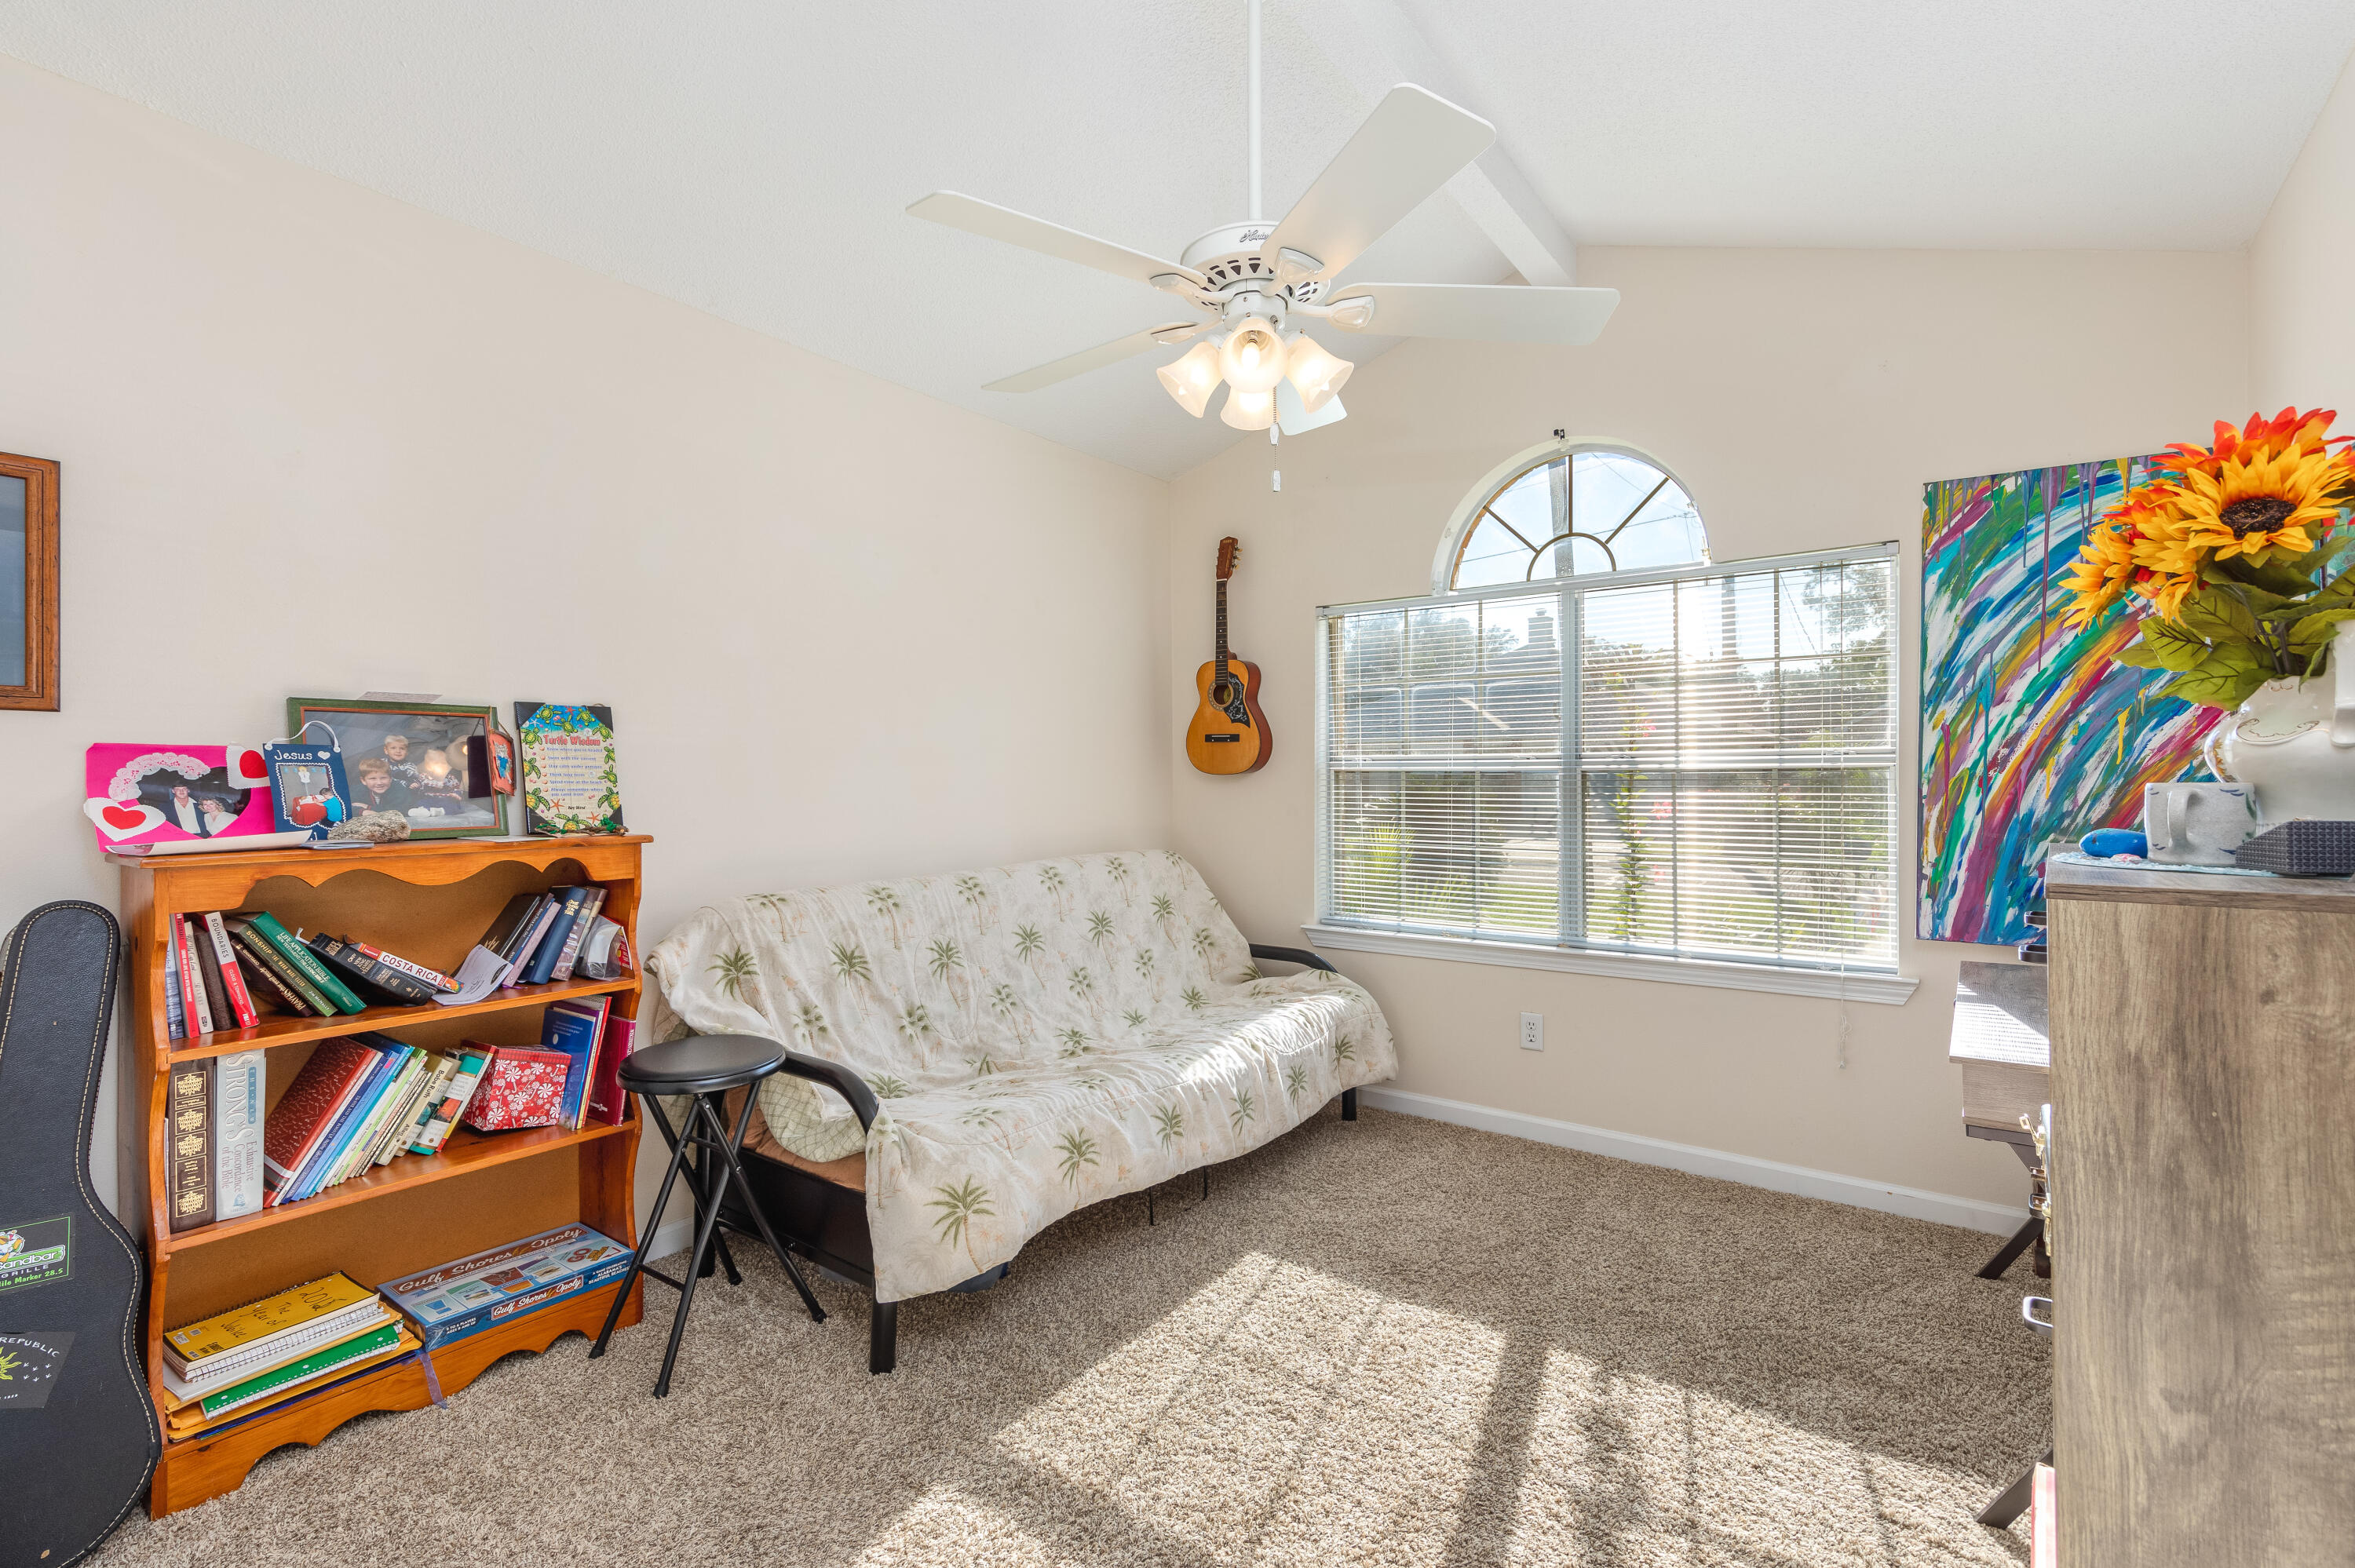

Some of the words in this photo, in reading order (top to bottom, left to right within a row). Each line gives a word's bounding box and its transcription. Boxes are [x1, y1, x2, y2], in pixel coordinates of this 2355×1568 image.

[543, 735, 568, 745] Turtle
[570, 735, 601, 746] Wisdom
[274, 750, 312, 760] Jesus
[211, 918, 228, 957] BOUNDARIES
[246, 931, 272, 954] SONSHIP
[325, 940, 338, 951] HOLY
[328, 942, 344, 957] BIBLE
[279, 932, 292, 943] LIFE
[290, 942, 318, 968] APPLICATION
[316, 966, 330, 981] BIBLE
[382, 954, 414, 973] COSTA
[414, 967, 439, 983] RICA
[432, 1070, 444, 1085] Babe
[225, 1053, 255, 1142] STRONG'S
[423, 1085, 435, 1098] Ruth
[398, 1124, 410, 1136] Allen
[222, 1147, 233, 1156] of
[222, 1157, 233, 1167] the
[233, 1144, 246, 1192] Concordance
[246, 1140, 257, 1181] Exhaustive
[221, 1168, 233, 1189] Bible
[399, 1272, 444, 1292] Gulf
[451, 1252, 513, 1275] Shores
[531, 1229, 582, 1248] Opoly
[1, 1264, 49, 1278] GRILLE
[14, 1274, 42, 1284] Marker
[44, 1268, 64, 1277] 28.5
[588, 1274, 610, 1285] BEAUTIFUL
[611, 1267, 630, 1277] BEACHES
[597, 1265, 623, 1278] ALABAMA'S
[494, 1301, 516, 1316] Gulf
[517, 1291, 547, 1307] Shores
[556, 1278, 582, 1293] Opoly
[276, 1301, 292, 1315] The
[460, 1317, 476, 1326] PLAYERS
[0, 1336, 60, 1358] REPUBLIC
